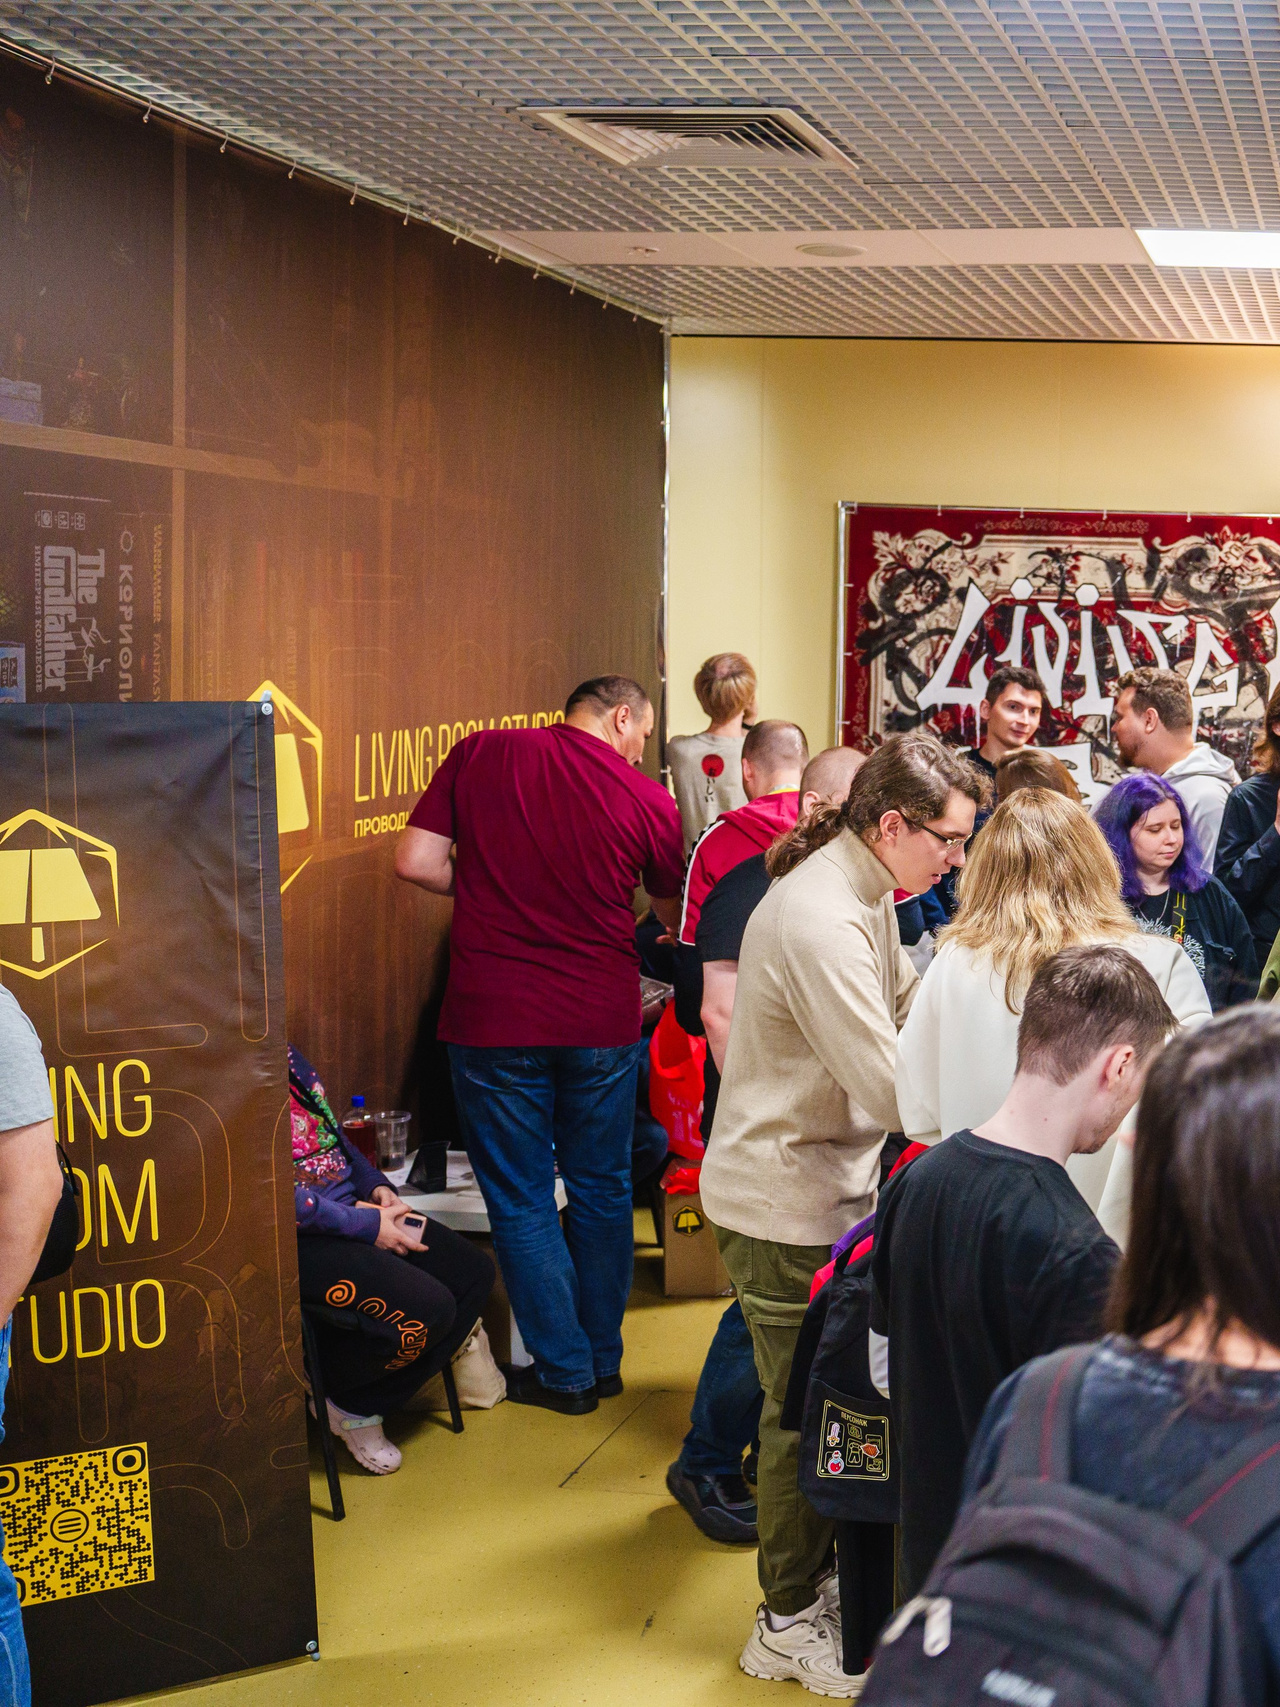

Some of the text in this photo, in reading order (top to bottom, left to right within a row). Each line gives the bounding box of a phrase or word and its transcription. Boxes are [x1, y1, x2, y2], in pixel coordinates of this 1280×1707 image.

[77, 548, 105, 604] The
[35, 617, 43, 693] КОРЛЕОНЕ
[43, 545, 77, 692] Godfather
[354, 715, 434, 803] LIVING
[354, 811, 410, 839] ПРОВОД
[49, 1059, 153, 1142] ING
